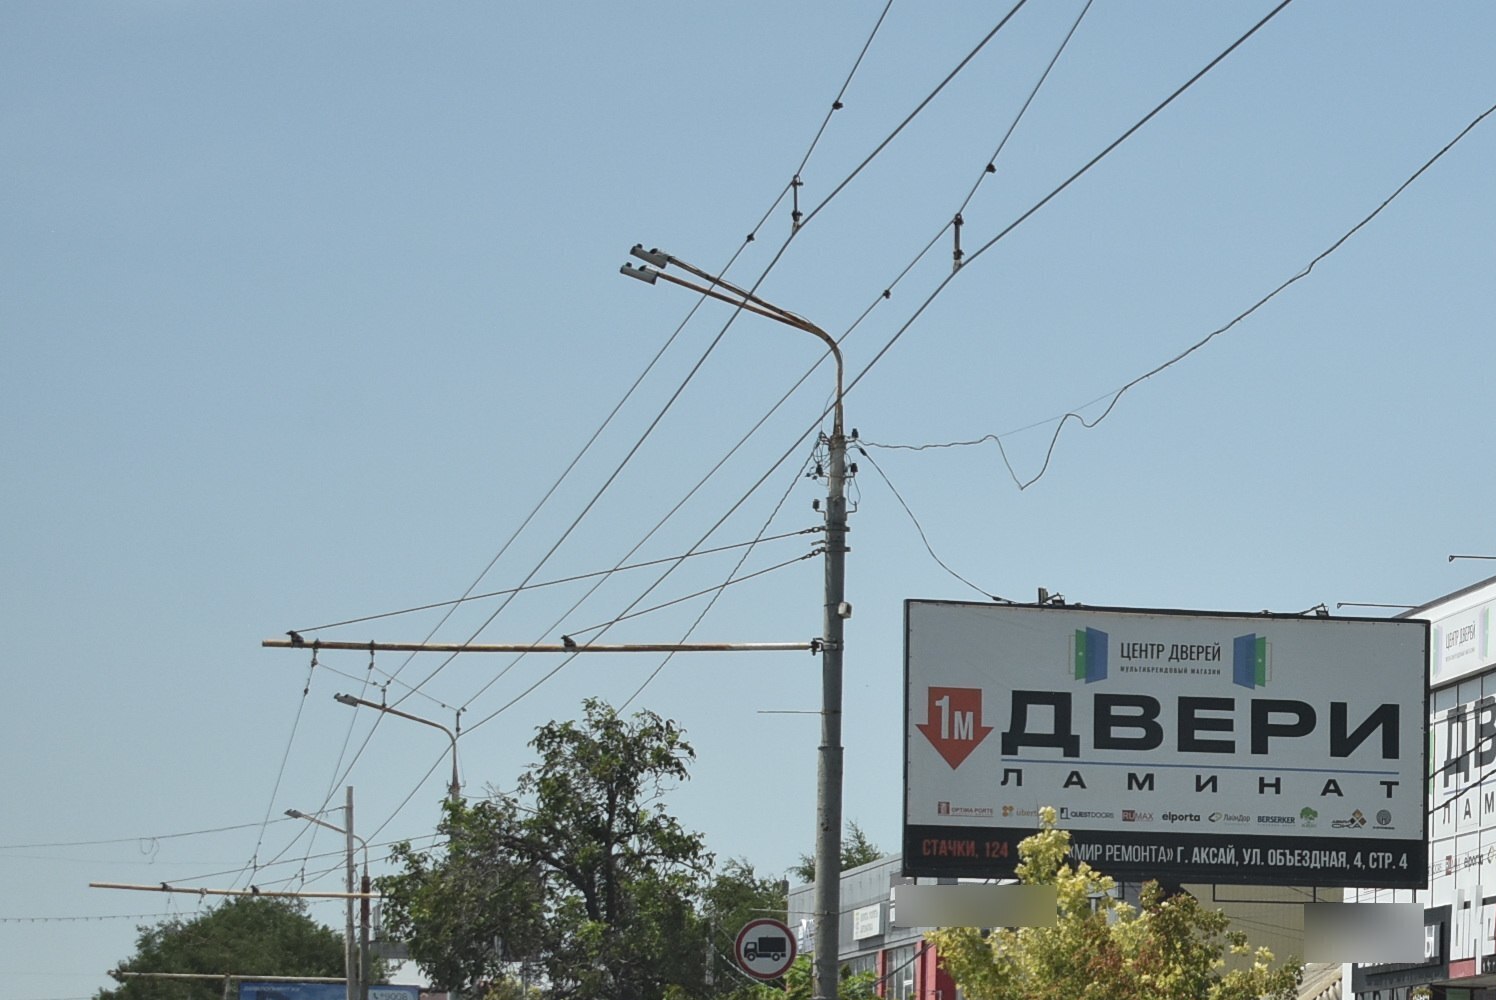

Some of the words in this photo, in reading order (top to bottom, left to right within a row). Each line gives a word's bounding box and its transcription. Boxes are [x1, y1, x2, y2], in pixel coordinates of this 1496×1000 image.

[1120, 642, 1165, 660] ЦЕНТР
[1168, 642, 1221, 662] ДВЕРЕЙ
[1120, 666, 1188, 675] МУЛЬТИБРЕНДОВЫЙ
[1190, 667, 1221, 676] МАГАЗИН
[1001, 690, 1400, 760] ДВЕРИ
[1001, 768, 1400, 799] ЛАМИНАТ
[1070, 811, 1114, 819] QUESTDOORS
[1162, 812, 1200, 823] elporta
[1257, 815, 1295, 824] BERSERKER
[922, 839, 979, 858] СТАЧКИ,
[985, 842, 1008, 858] 124
[1105, 845, 1173, 862] РЕМОНТА»
[1177, 847, 1188, 864] Г.
[1191, 845, 1239, 866] АКСАЙ,
[1243, 849, 1264, 865] УЛ.
[1268, 849, 1350, 870] ОБЪЕЗДНАЯ,
[1353, 852, 1366, 870] 4,
[1369, 852, 1396, 869] СТР.
[1399, 853, 1408, 869] 4
